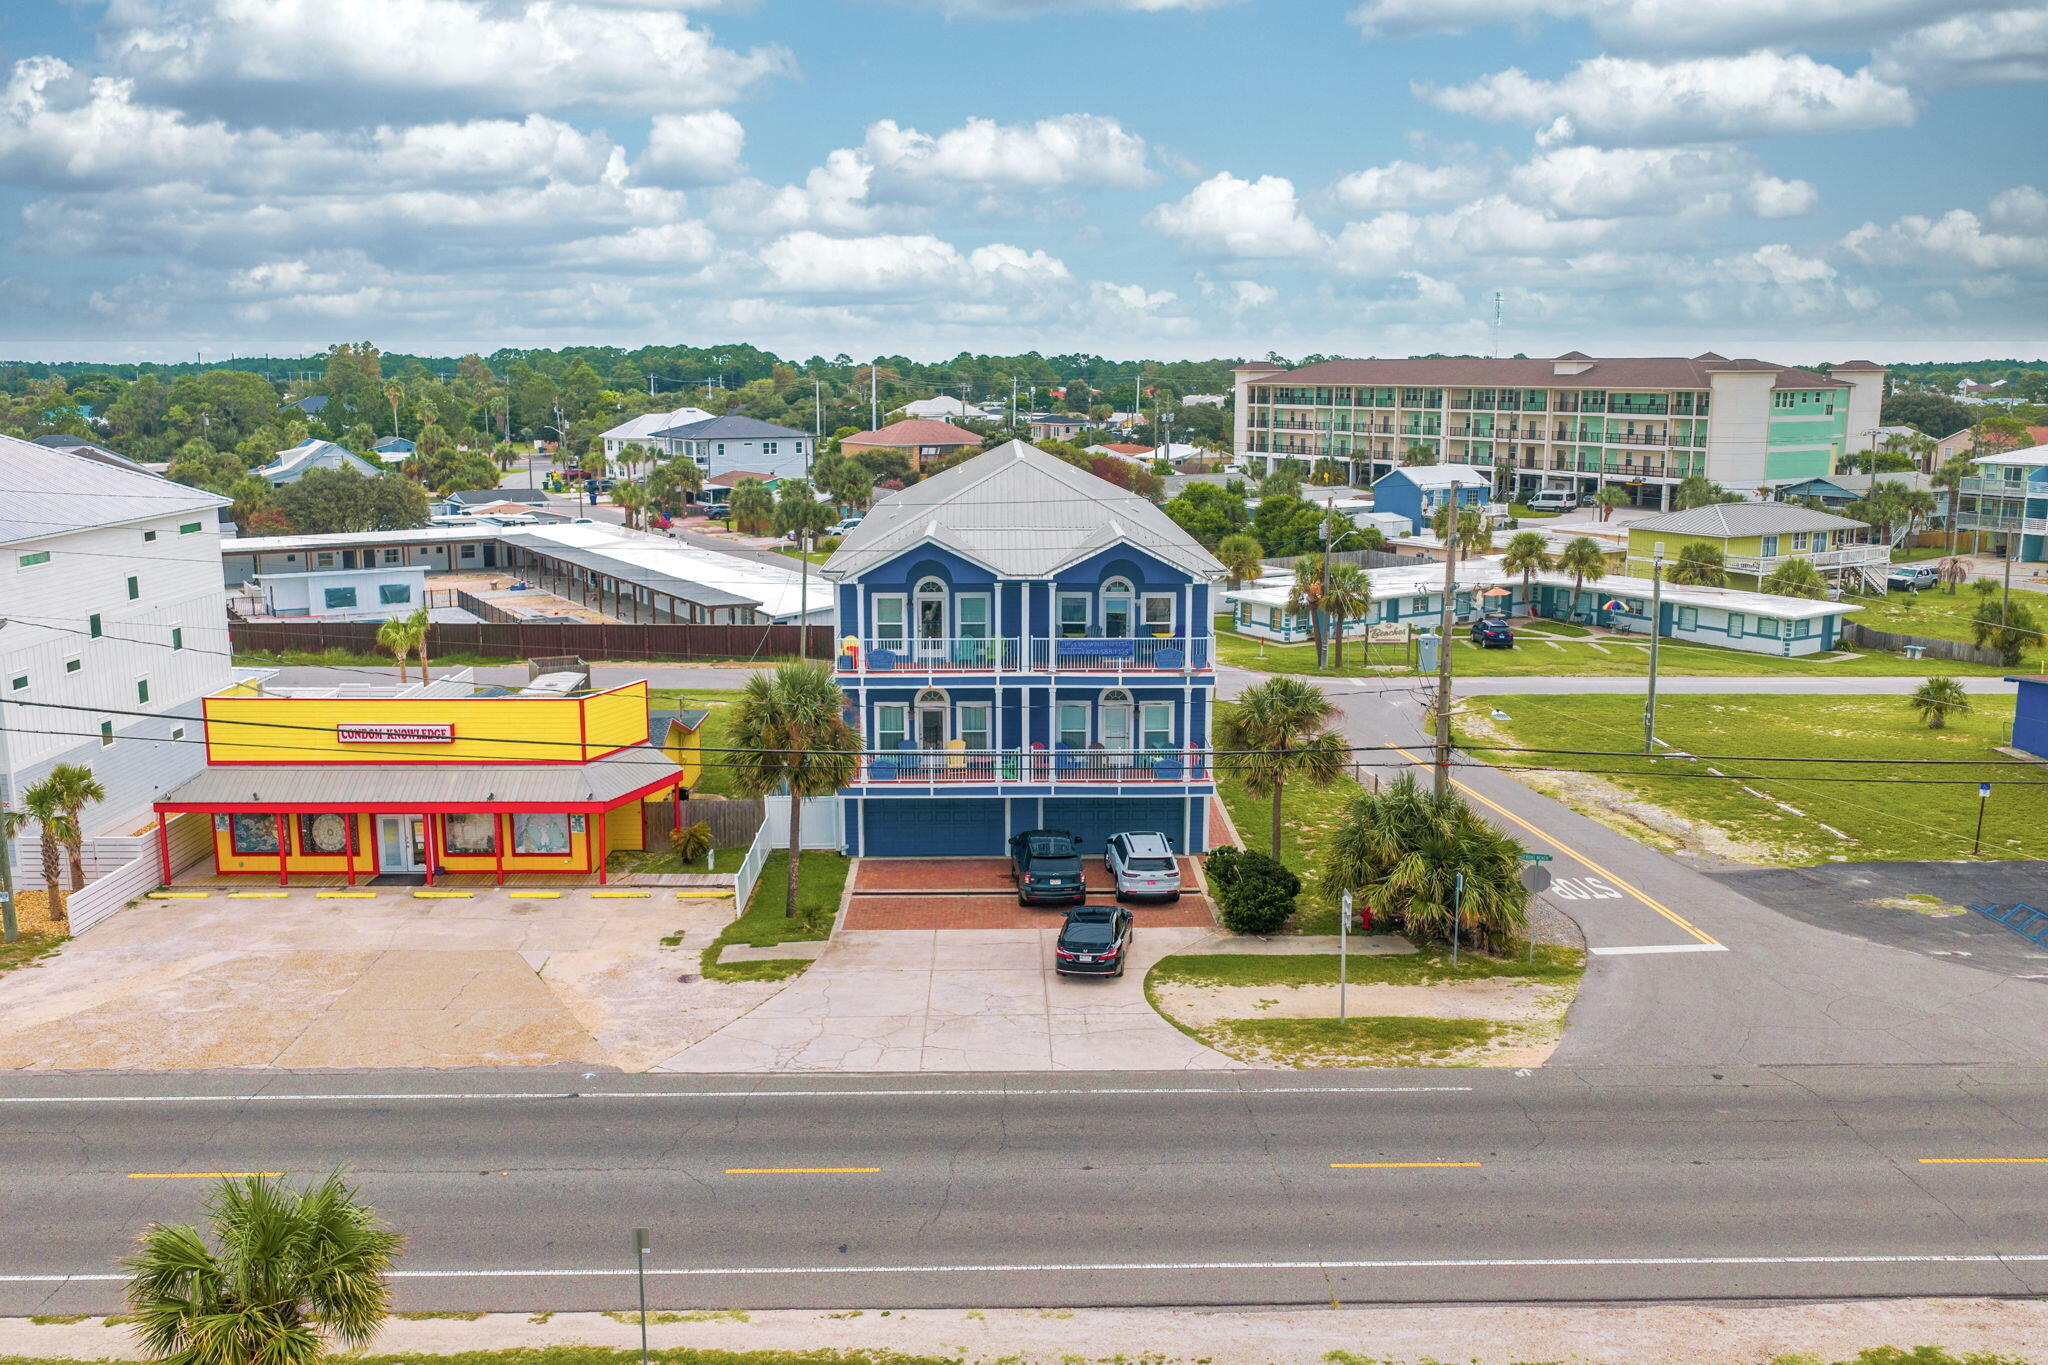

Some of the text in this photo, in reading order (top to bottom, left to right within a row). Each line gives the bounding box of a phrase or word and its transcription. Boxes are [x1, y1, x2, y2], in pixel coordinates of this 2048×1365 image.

[341, 728, 447, 740] CONDOM KNOWLEDGE
[1550, 877, 1623, 900] STOP
